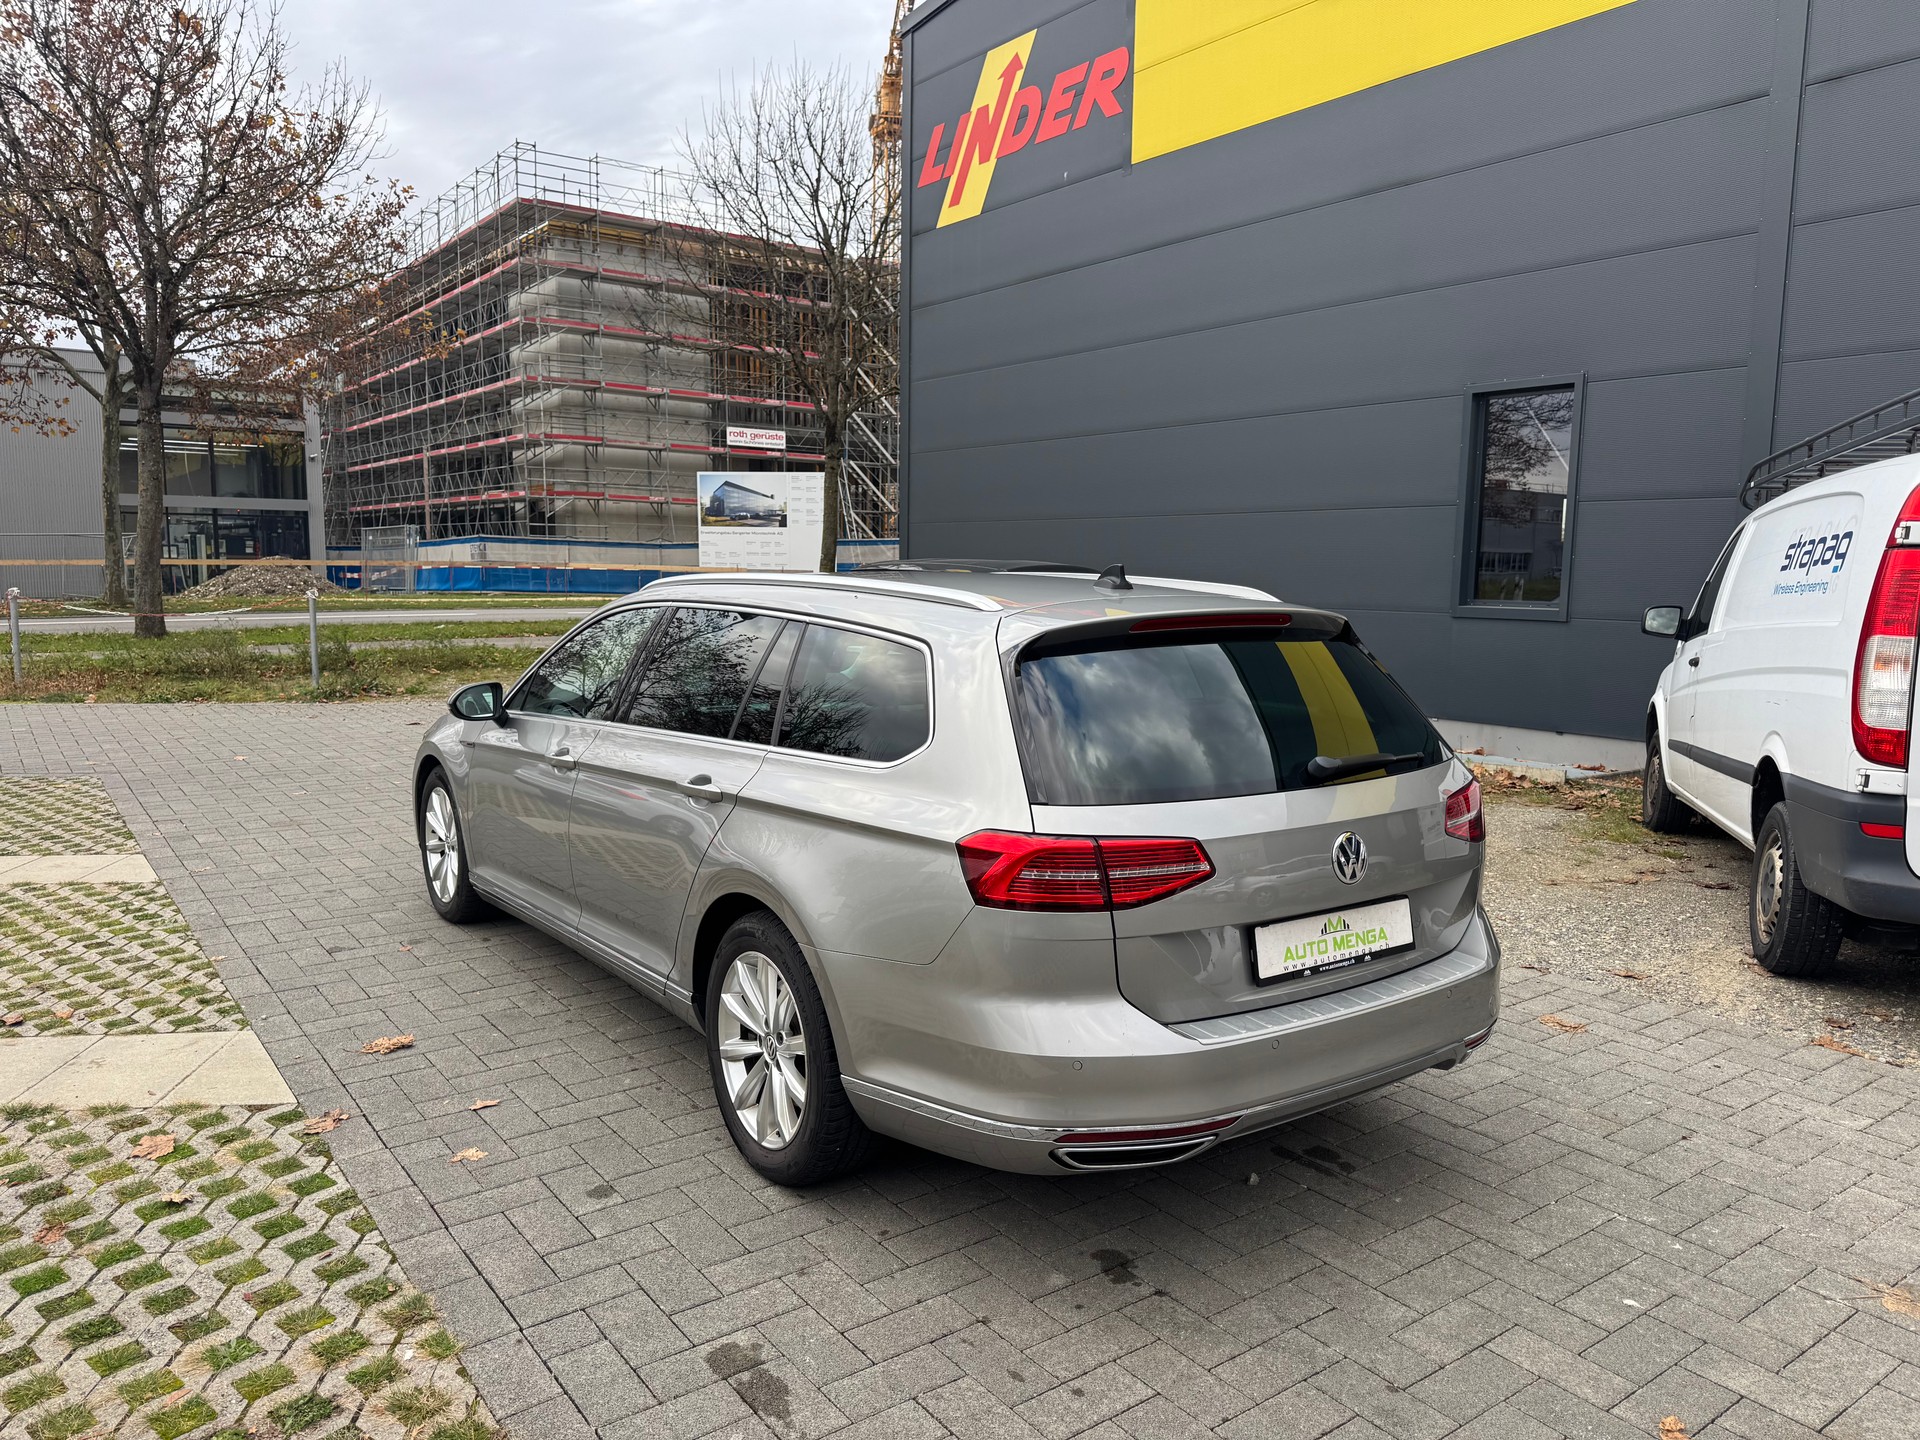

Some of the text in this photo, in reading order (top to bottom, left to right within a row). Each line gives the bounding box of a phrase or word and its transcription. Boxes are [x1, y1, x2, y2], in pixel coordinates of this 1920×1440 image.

[917, 46, 1130, 208] LINDER
[729, 430, 785, 441] roth gerüste
[1773, 579, 1829, 596] Wireless Engineering
[1283, 927, 1389, 963] AUTO MENGA
